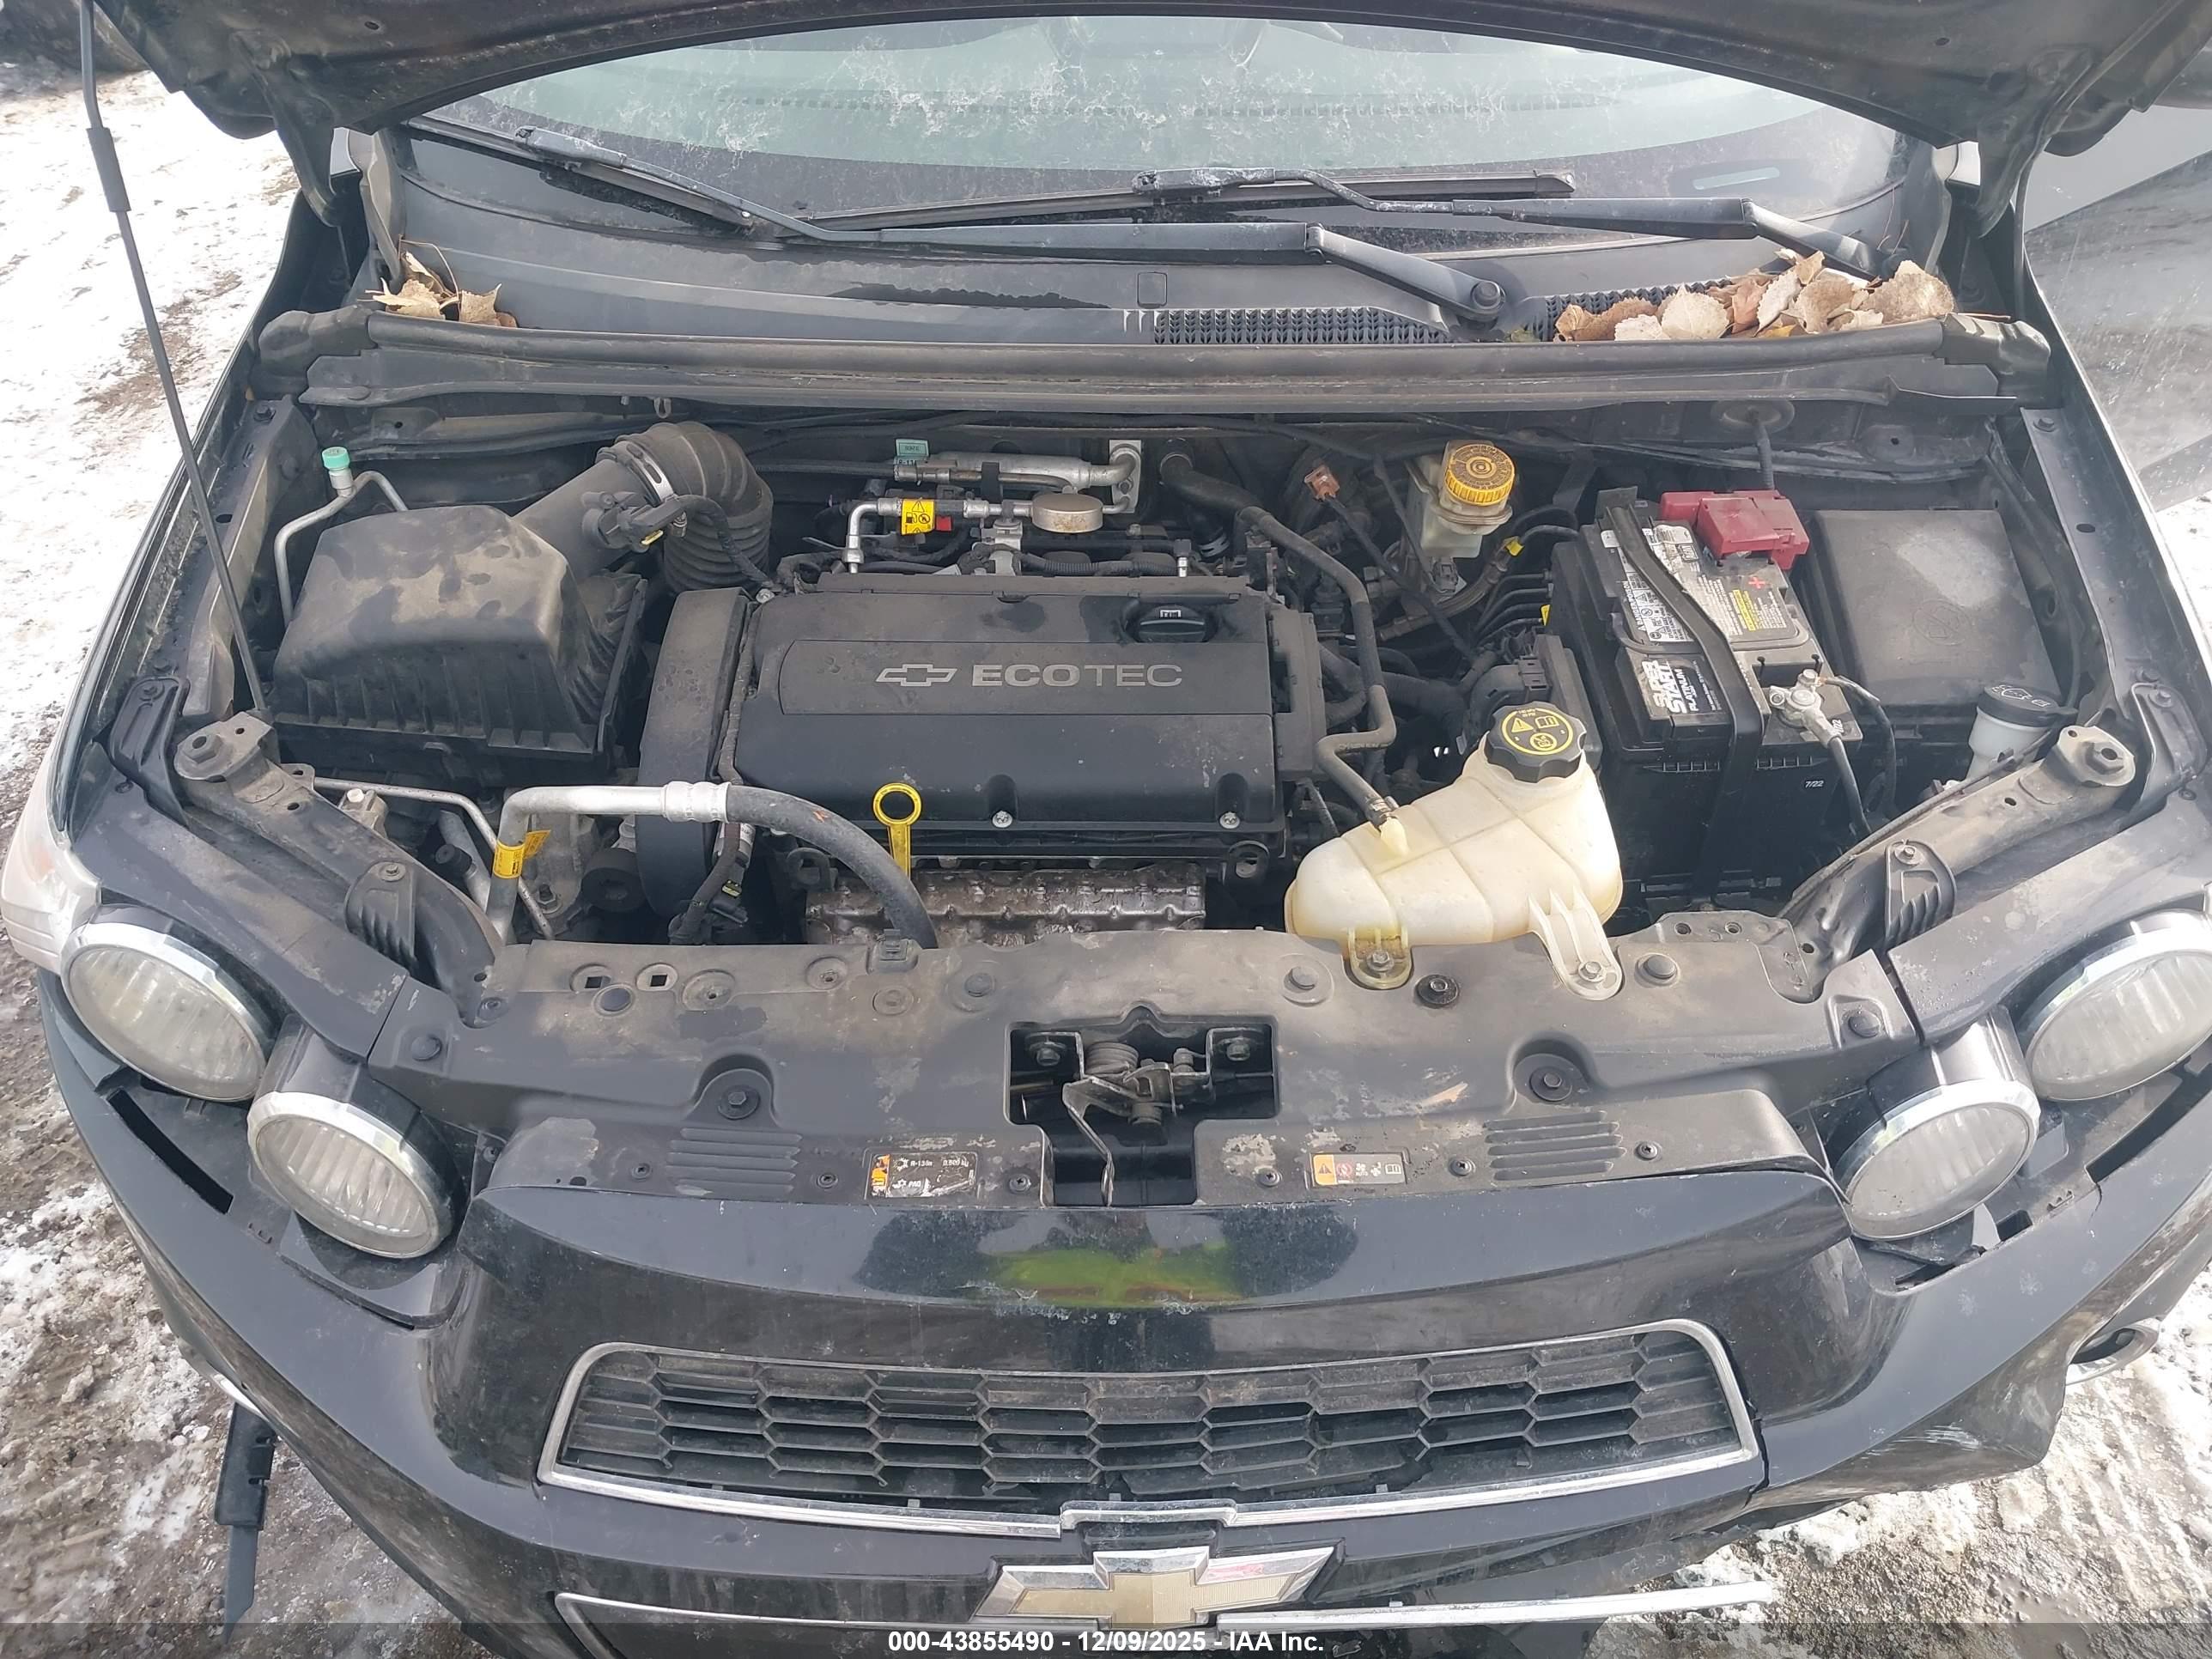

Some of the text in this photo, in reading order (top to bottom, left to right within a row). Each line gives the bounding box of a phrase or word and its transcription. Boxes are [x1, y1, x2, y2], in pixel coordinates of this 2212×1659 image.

[971, 664, 1182, 687] ECOTEC
[1641, 660, 1668, 708] SUPER
[1658, 665, 1687, 714] START
[1674, 669, 1699, 711] PLATINUM
[1805, 780, 1825, 788] 7/22
